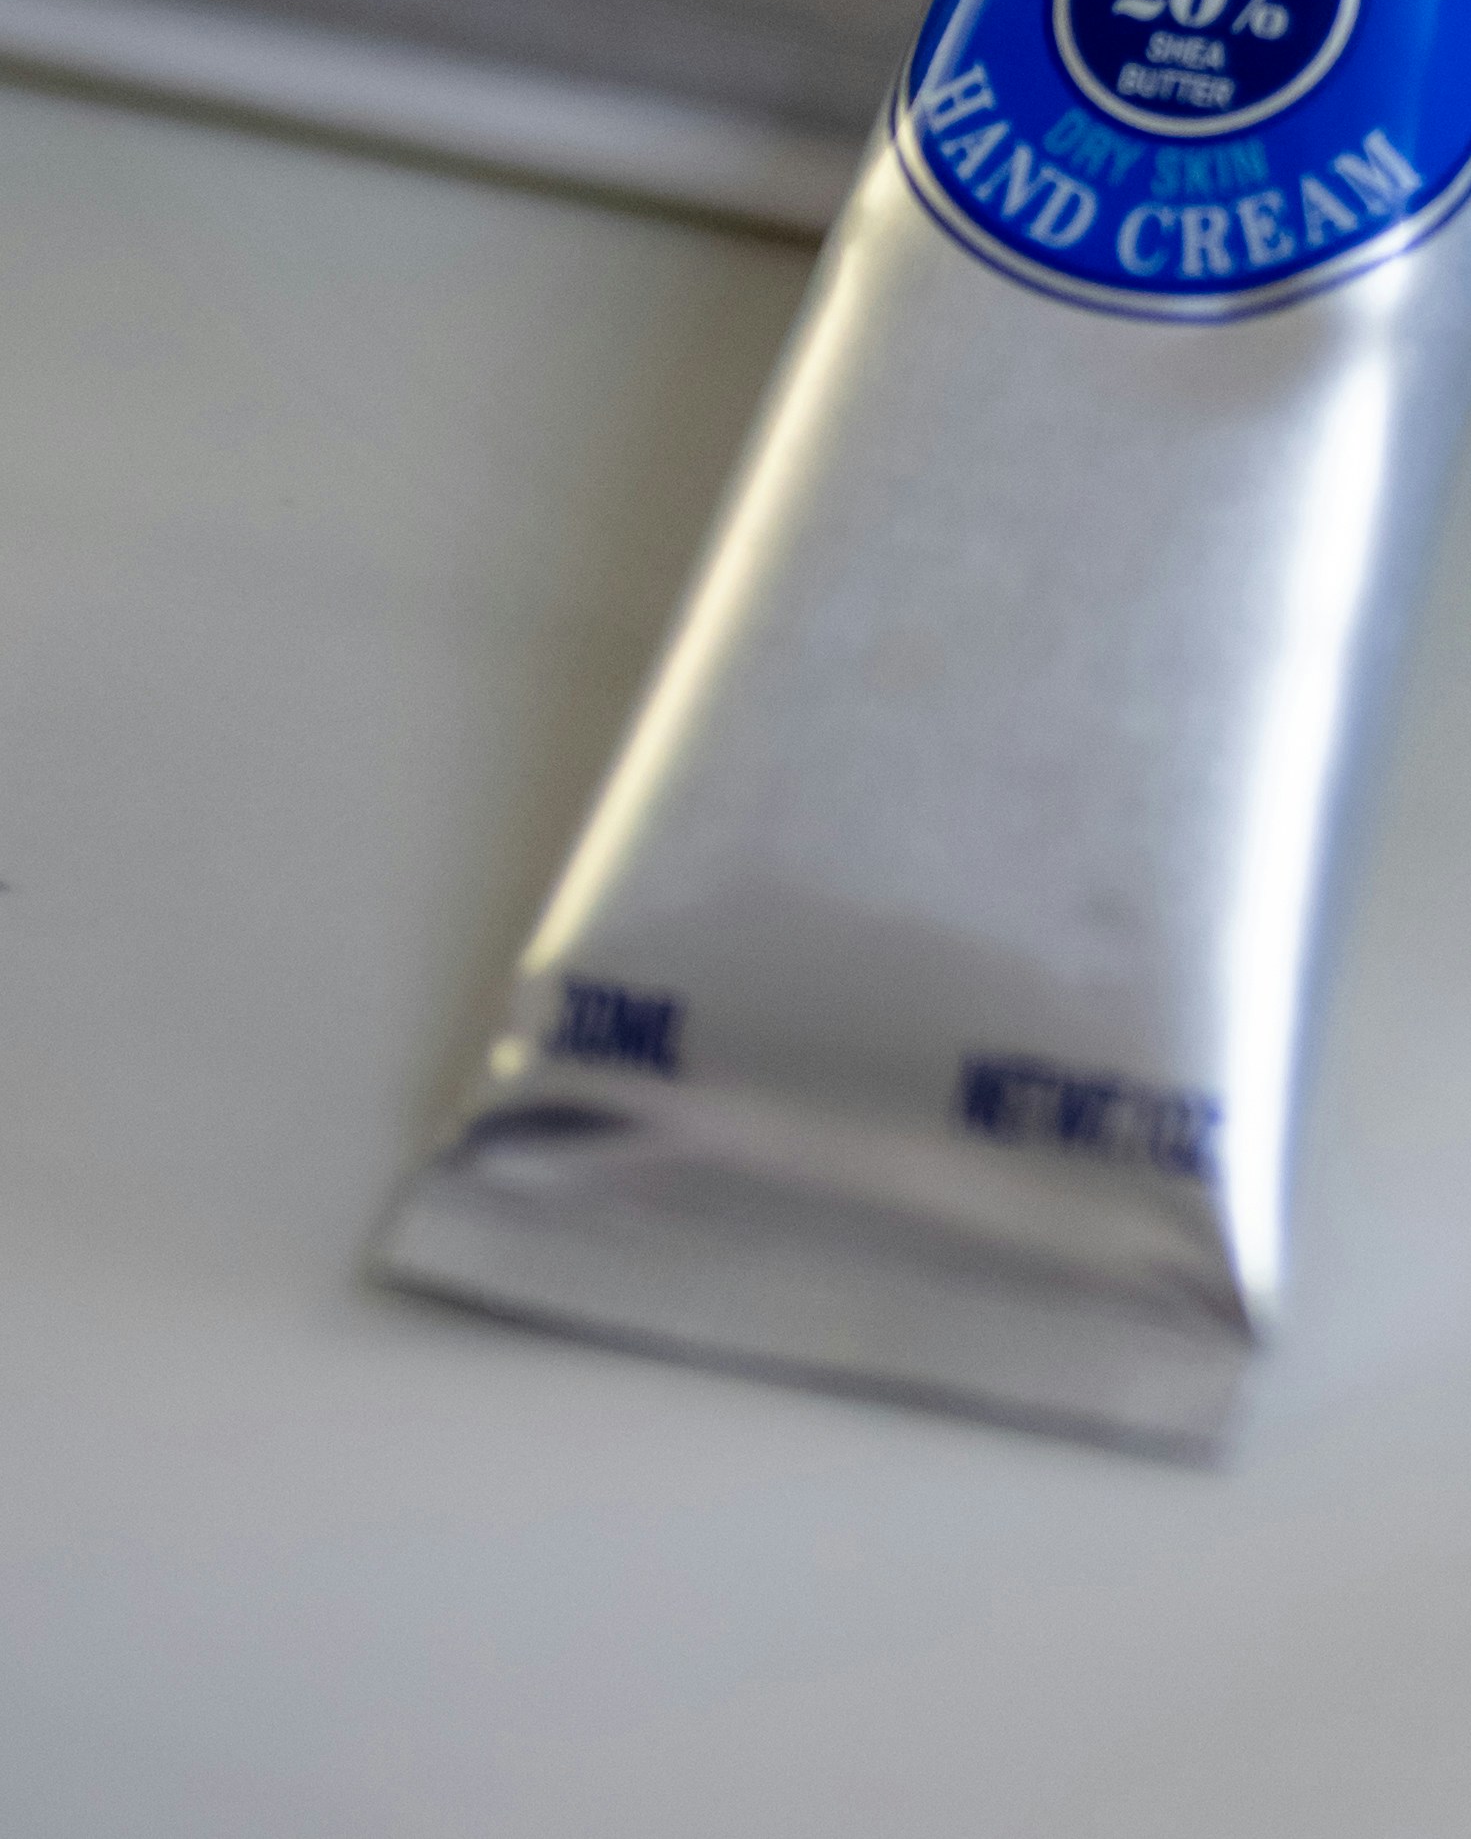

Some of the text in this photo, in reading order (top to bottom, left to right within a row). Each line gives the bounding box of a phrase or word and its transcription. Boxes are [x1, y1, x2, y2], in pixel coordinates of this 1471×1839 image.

[1146, 30, 1226, 71] SHEA
[1117, 62, 1236, 110] BUTTER
[921, 63, 1423, 279] HAND CREAM
[1043, 108, 1271, 198] DRY SKIN
